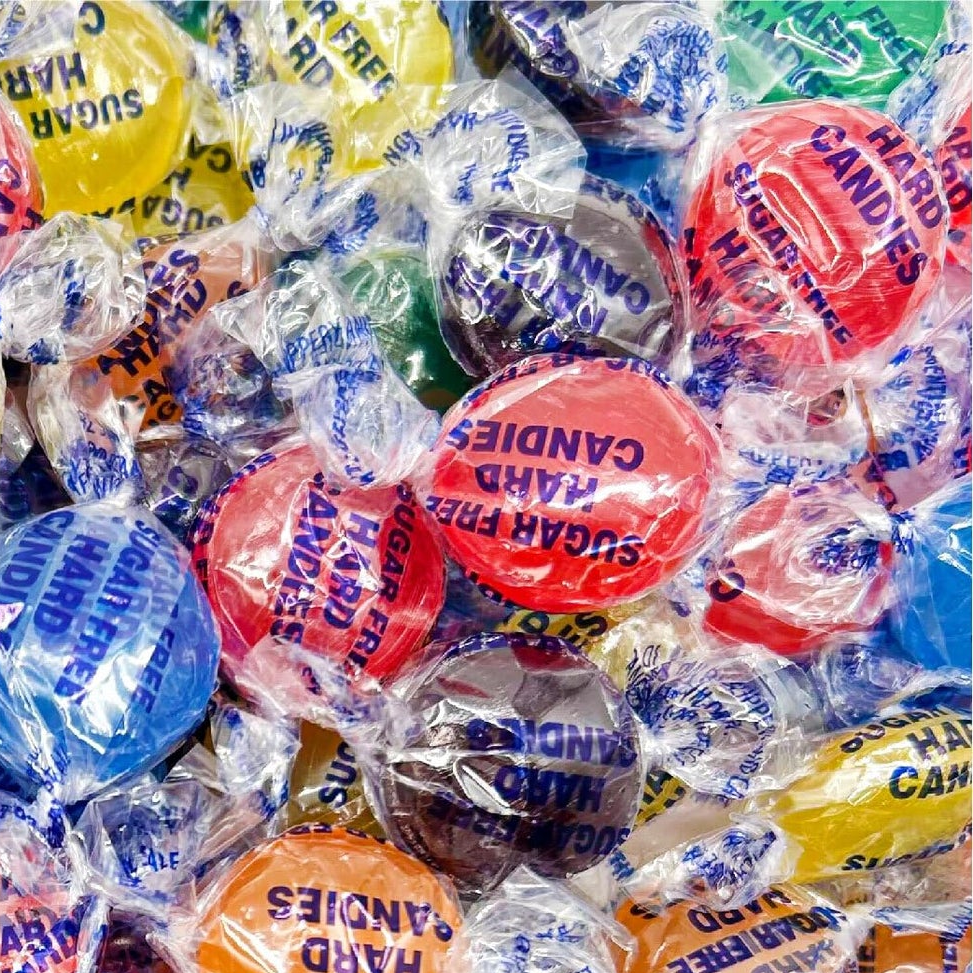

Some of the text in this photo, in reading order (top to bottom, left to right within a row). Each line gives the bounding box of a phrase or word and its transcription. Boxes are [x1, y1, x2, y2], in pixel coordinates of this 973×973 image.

[30, 88, 145, 139] SUGAR
[864, 125, 945, 229] HARD
[810, 125, 929, 287] CANDIES
[445, 419, 645, 472] CANDIES
[474, 463, 598, 513] HARD
[511, 512, 645, 567] SUGAR
[34, 534, 110, 634] HARD
[325, 512, 381, 630] HARD
[268, 886, 453, 942] CANDIES
